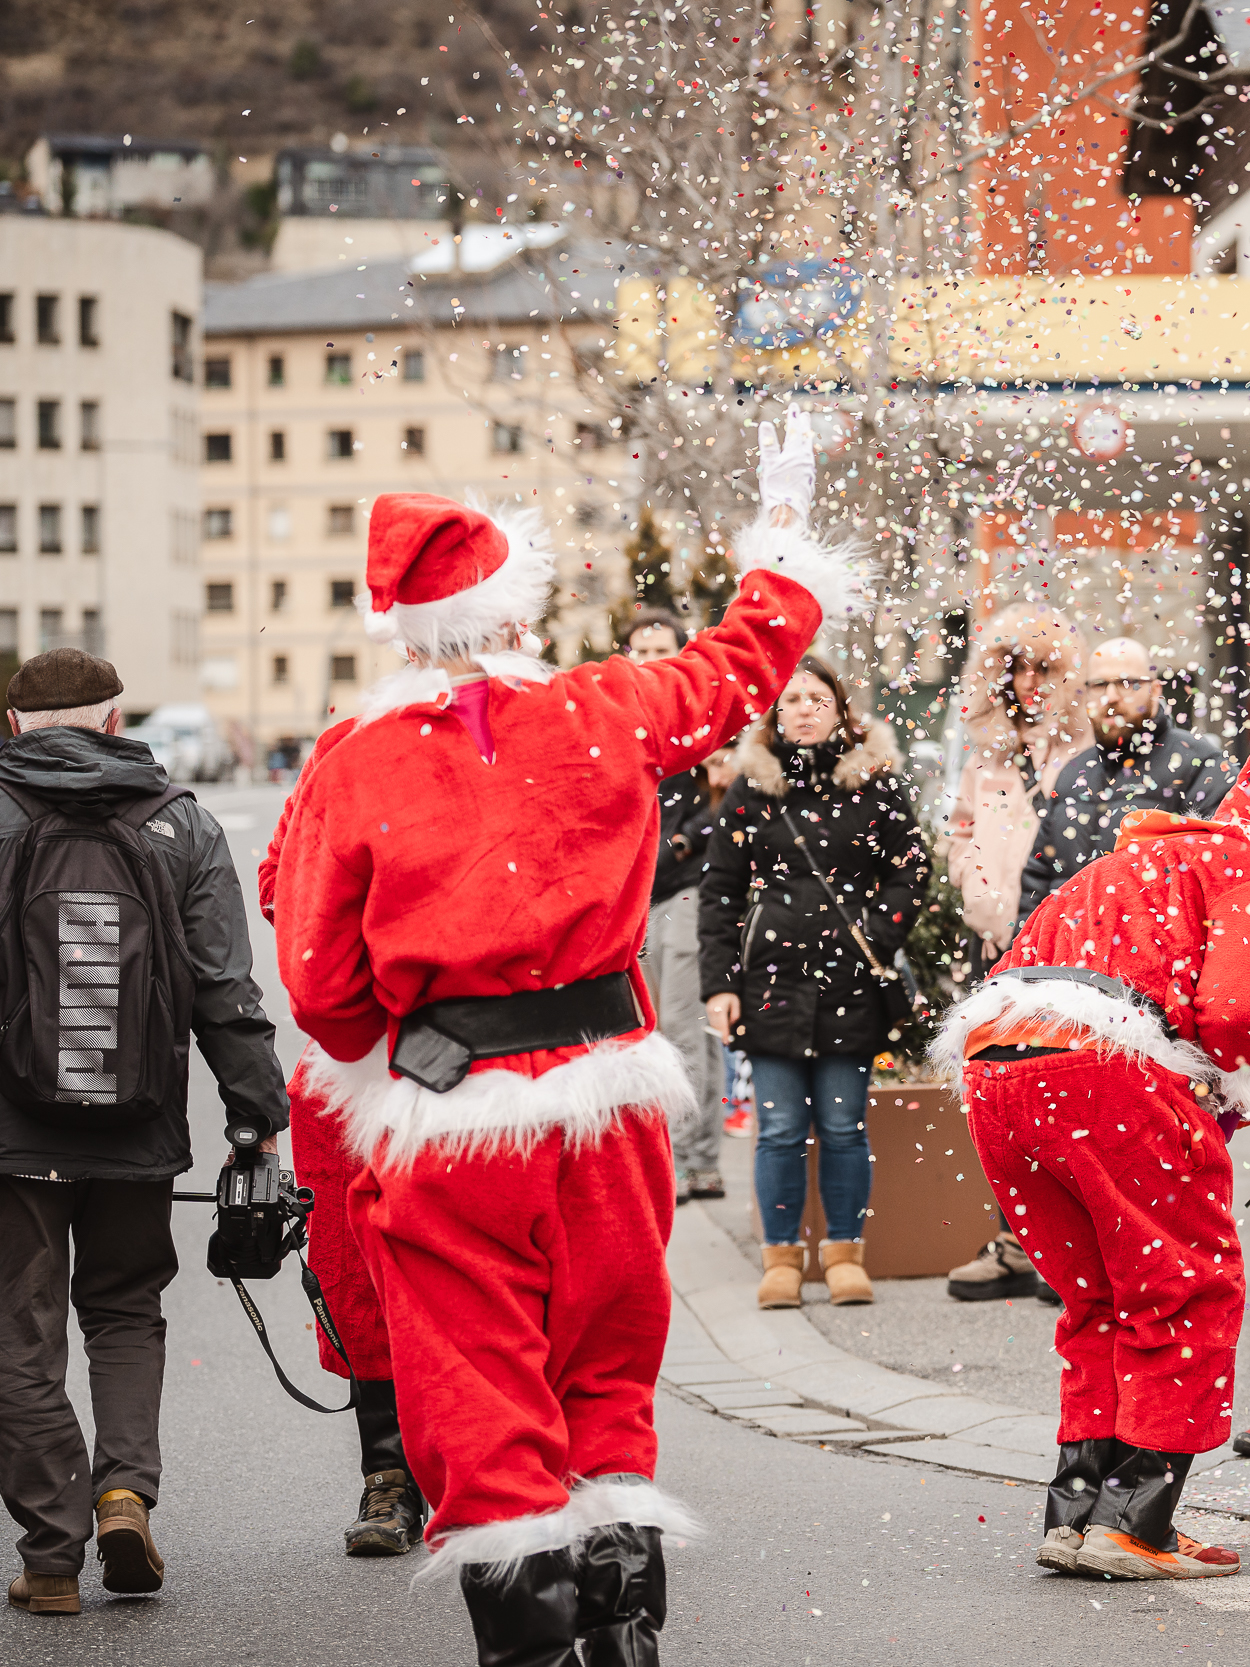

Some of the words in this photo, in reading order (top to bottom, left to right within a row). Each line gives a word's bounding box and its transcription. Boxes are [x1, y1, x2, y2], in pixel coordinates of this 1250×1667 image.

[55, 892, 120, 1103] PUMA
[237, 1284, 263, 1331] Panasonic
[314, 1297, 341, 1349] Panasonic
[1128, 1539, 1160, 1556] SALOMON
